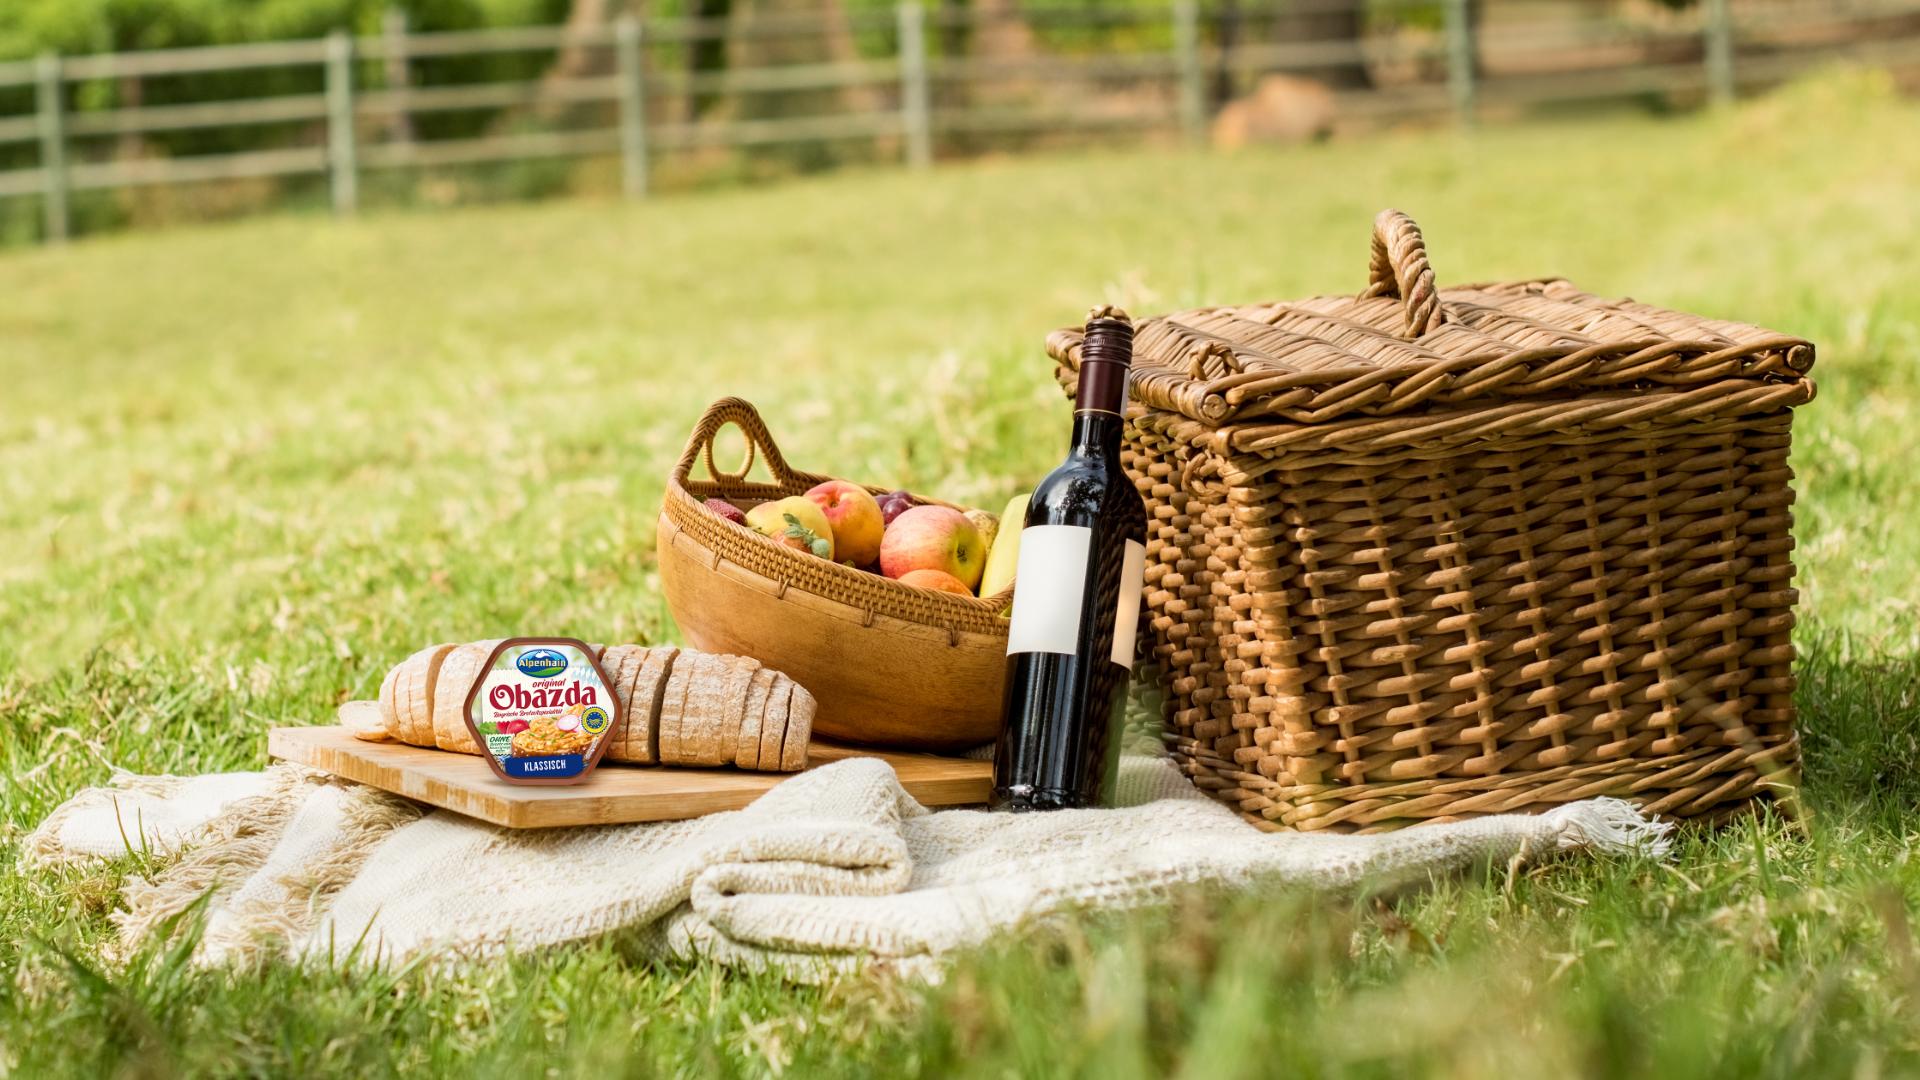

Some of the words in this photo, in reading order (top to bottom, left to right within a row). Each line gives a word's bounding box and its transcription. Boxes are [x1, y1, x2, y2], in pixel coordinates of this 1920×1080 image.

[519, 659, 566, 668] Alpenhain
[532, 679, 566, 689] original
[489, 680, 597, 710] Obazda
[524, 760, 567, 772] KLASSISCH
